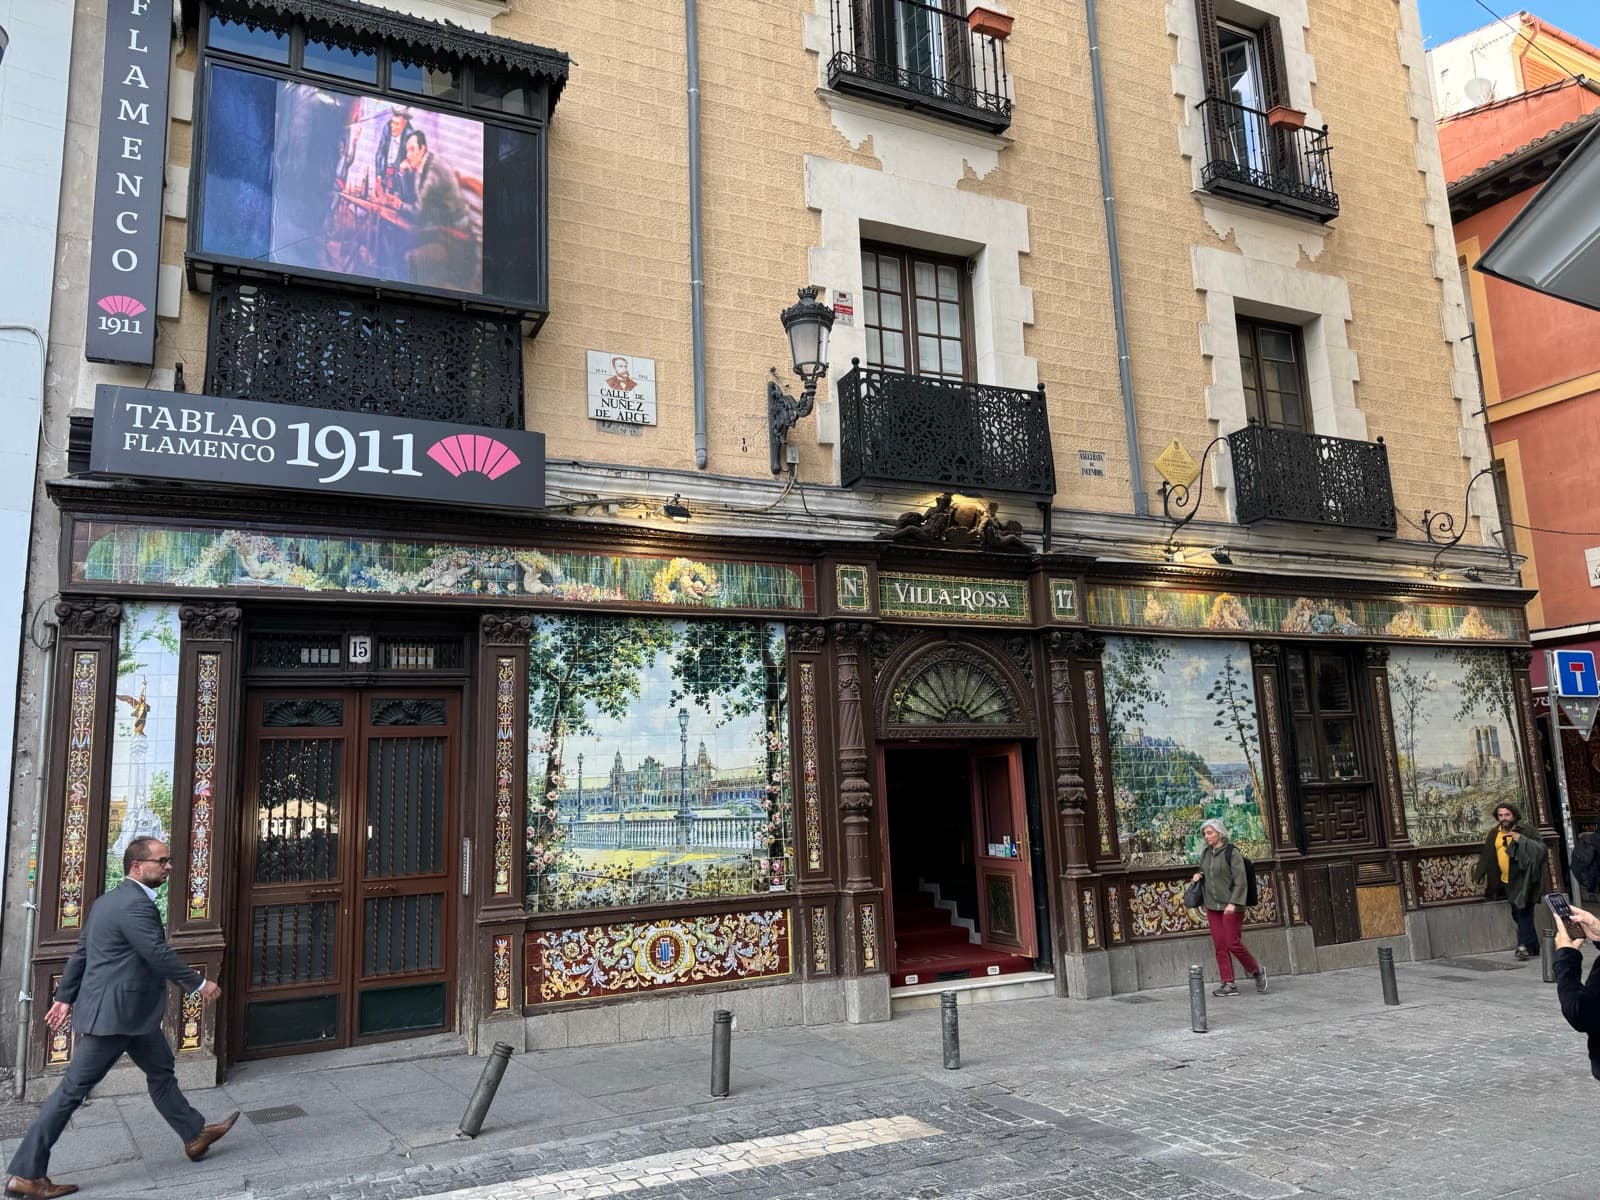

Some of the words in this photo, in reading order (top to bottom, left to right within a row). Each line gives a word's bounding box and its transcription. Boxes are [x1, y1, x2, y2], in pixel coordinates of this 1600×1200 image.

[112, 0, 150, 272] FLAMENCO
[97, 317, 143, 335] 1911
[600, 388, 629, 399] CALLE
[126, 403, 276, 440] TABLAO
[595, 408, 611, 418] DE
[617, 410, 650, 424] ARCE
[122, 432, 275, 463] FLAMENCO
[286, 422, 423, 484] 1911
[894, 582, 1010, 611] VILLA-ROSA
[1055, 589, 1072, 609] 17
[352, 641, 368, 658] 15
